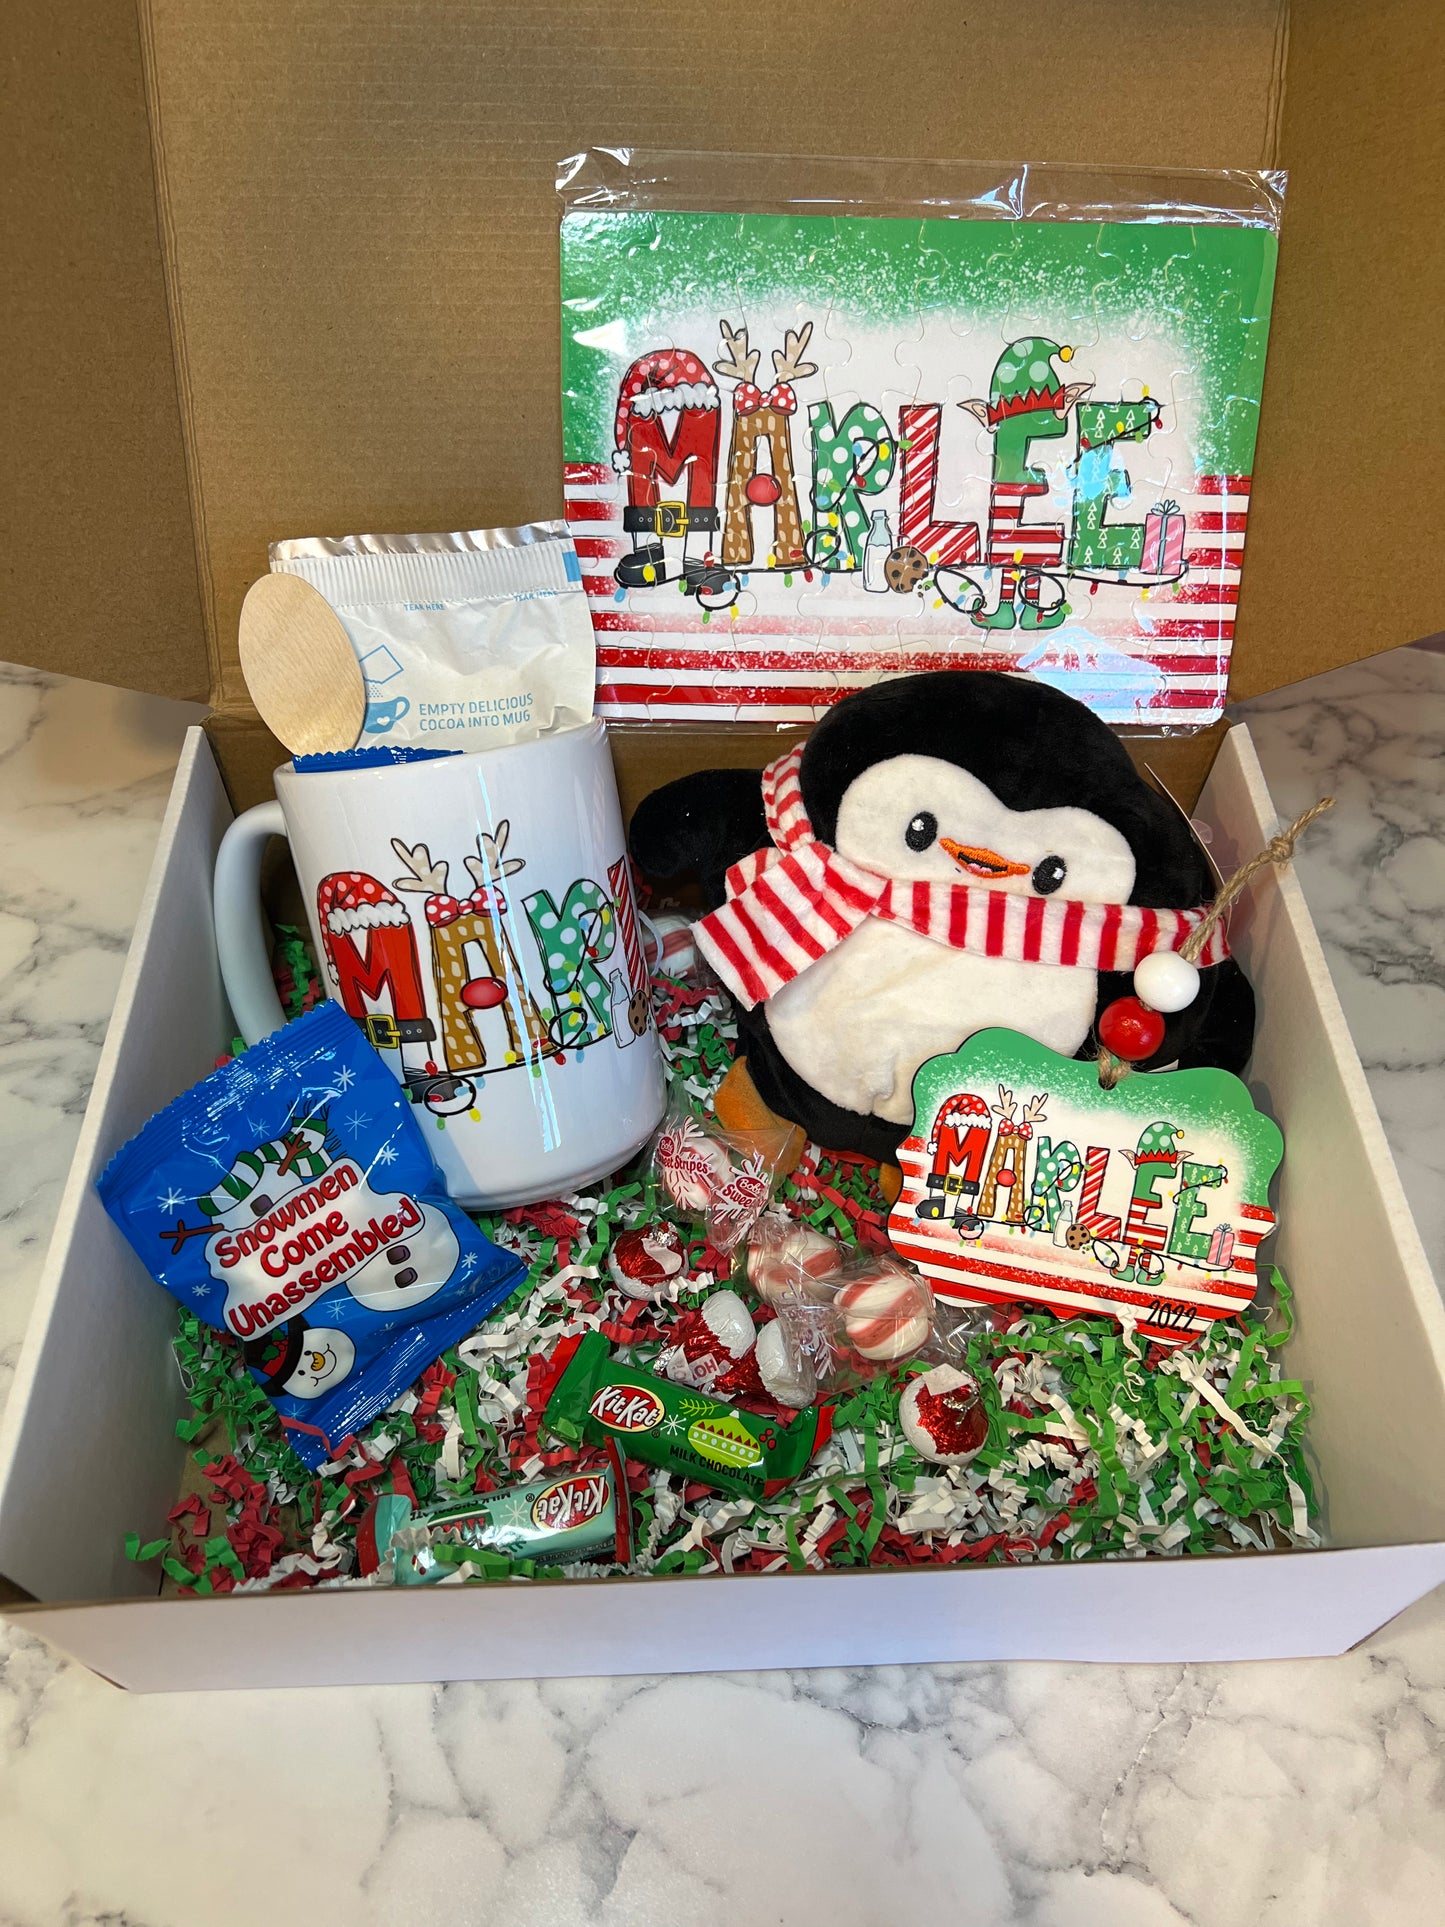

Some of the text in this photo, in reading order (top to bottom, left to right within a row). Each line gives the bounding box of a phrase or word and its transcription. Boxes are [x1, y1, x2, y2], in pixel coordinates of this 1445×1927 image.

[620, 350, 1158, 582] MARLEE
[403, 603, 446, 611] TEAR HERE
[419, 693, 534, 716] EMPTY DELICIOUS
[419, 709, 531, 731] COCOA INTO MUG
[674, 1154, 709, 1175] Stripes
[926, 1095, 1222, 1262] MARLEE
[722, 1183, 755, 1208] Swee
[214, 1164, 359, 1269] Snowmen
[259, 1210, 349, 1278] Come
[228, 1196, 421, 1337] Unassembled
[1144, 1299, 1198, 1335] 2022
[668, 1444, 765, 1486] MILK CHOCOLATE
